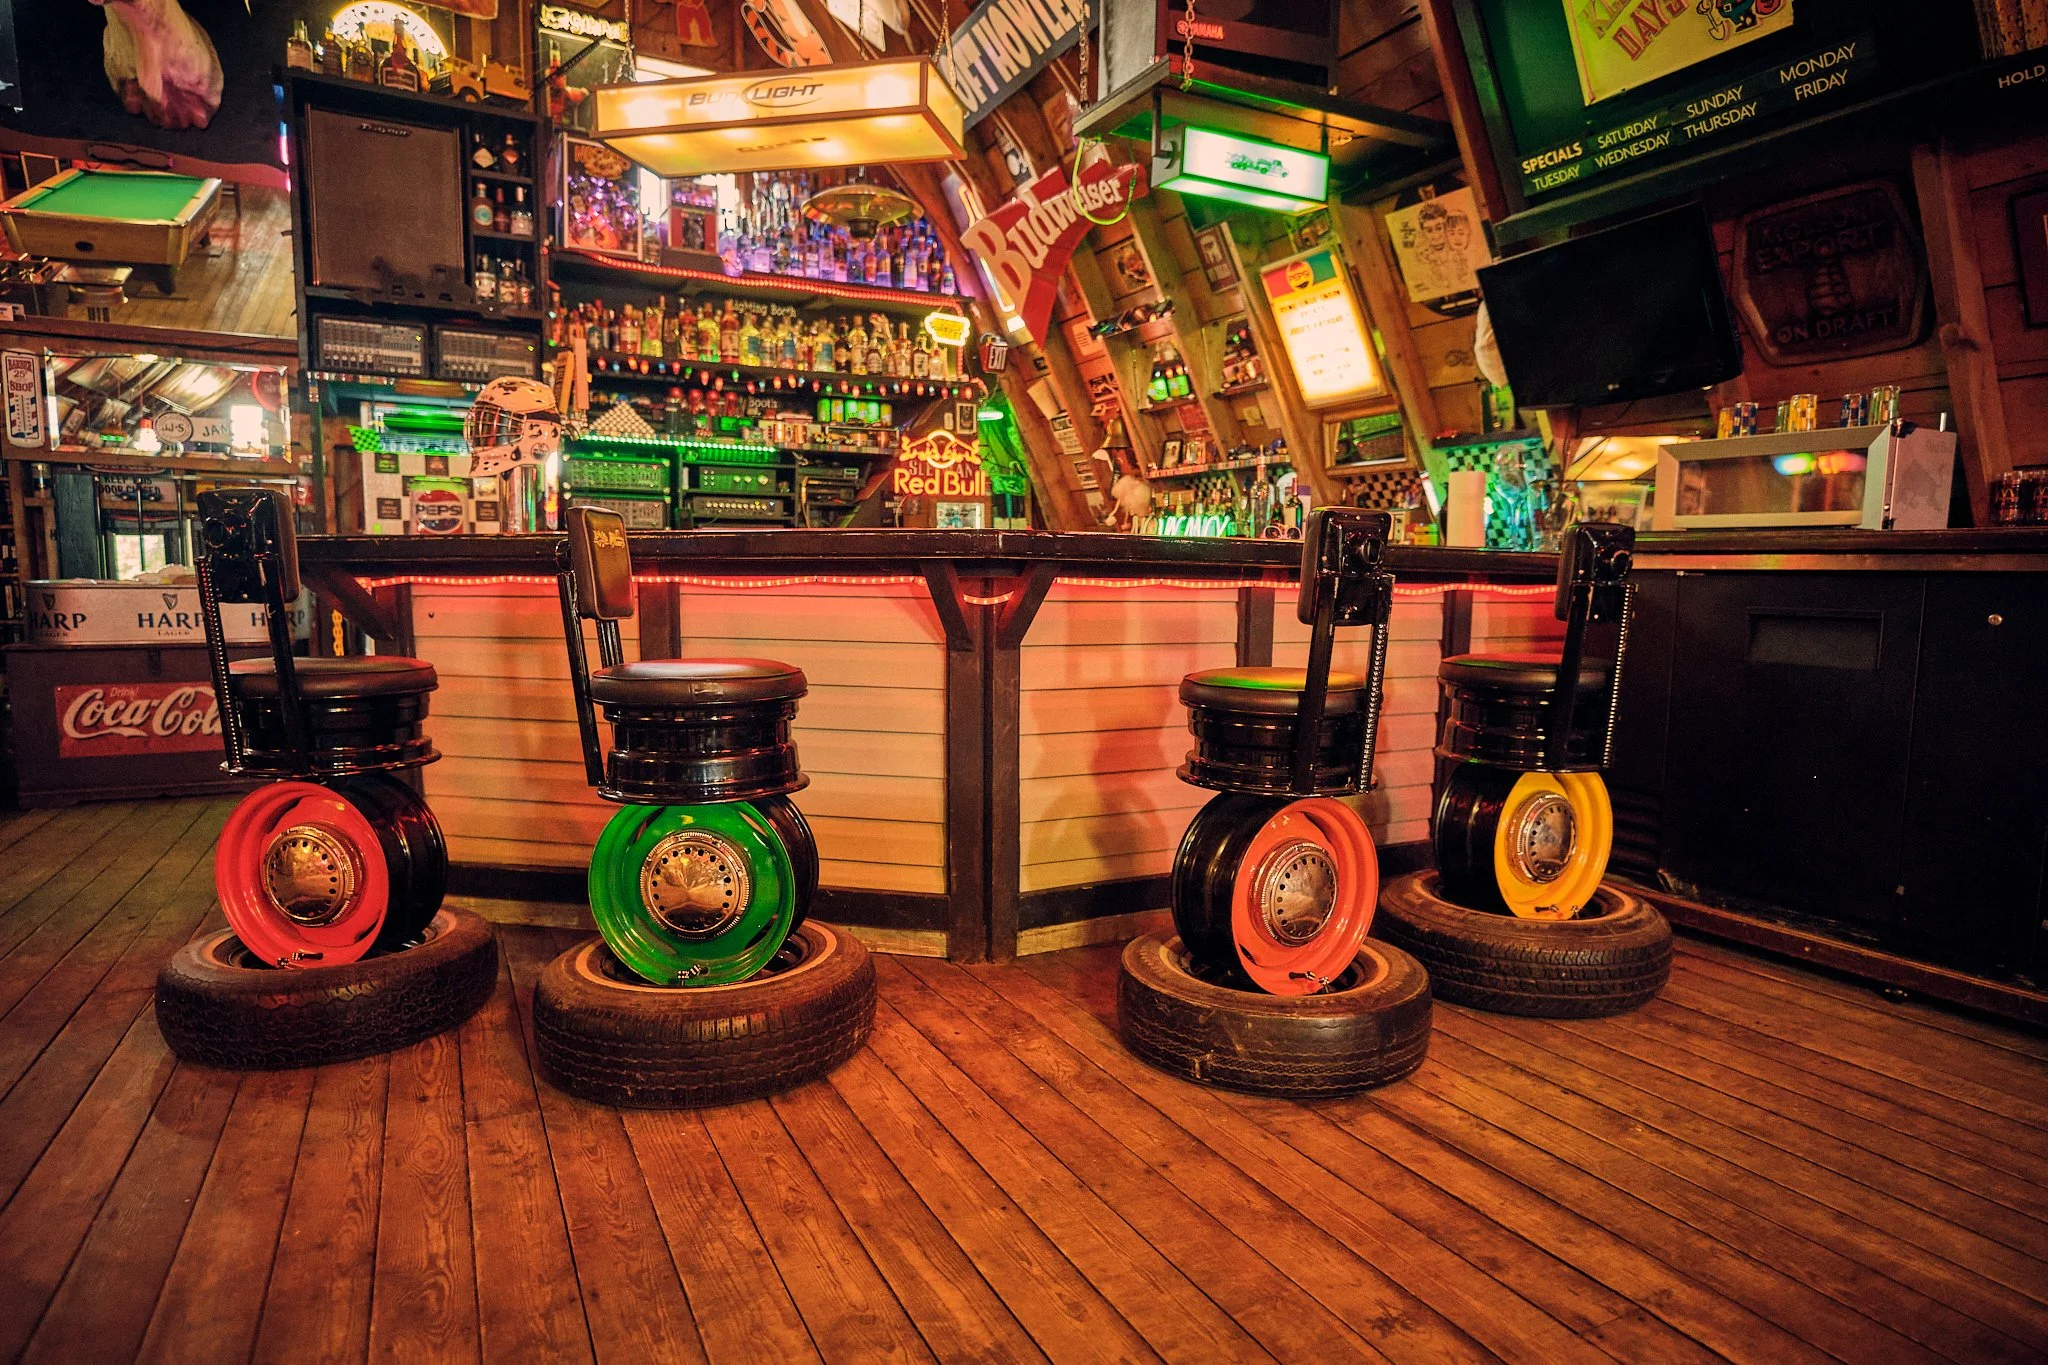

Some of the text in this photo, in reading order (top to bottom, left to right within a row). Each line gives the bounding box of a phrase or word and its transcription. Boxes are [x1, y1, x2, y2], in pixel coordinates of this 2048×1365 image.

[1780, 43, 1856, 84] MONDAY
[1998, 65, 2046, 89] HOLD
[689, 83, 824, 106] BUD LIGHT
[1795, 70, 1848, 101] FRIDAY
[1687, 86, 1744, 118] SUNDAY
[1597, 116, 1658, 149] SATURDAY
[1683, 102, 1758, 139] THURSDAY
[1521, 141, 1583, 175] SPECIALS
[1595, 132, 1670, 168] WEDNESDAY
[1532, 165, 1581, 192] TUESDAY
[959, 177, 1124, 317] Budweiser
[1775, 309, 1890, 345] ON DRAFT
[988, 345, 1008, 370] EXIT
[10, 380, 33, 392] SHOP
[894, 468, 939, 496] Red
[944, 470, 986, 496] Bull
[416, 504, 462, 516] PEPSI
[252, 612, 304, 628] HRP
[63, 686, 225, 739] Coca-Col
